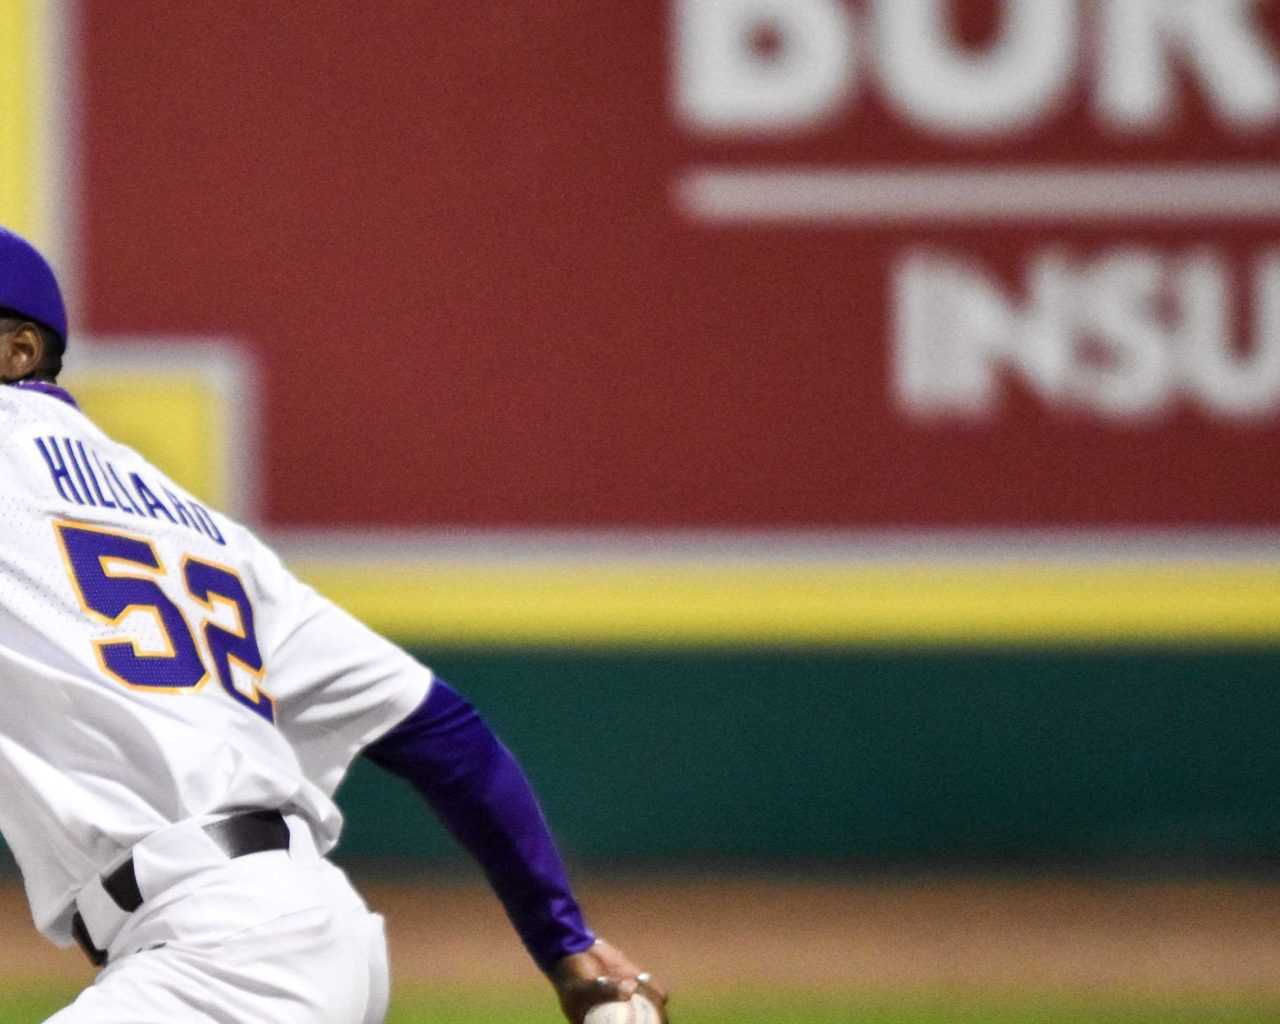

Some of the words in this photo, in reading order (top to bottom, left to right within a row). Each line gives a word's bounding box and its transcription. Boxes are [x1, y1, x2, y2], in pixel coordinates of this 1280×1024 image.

[892, 250, 1280, 420] INSU
[34, 435, 227, 546] HILLIARD
[52, 517, 279, 728] 52
